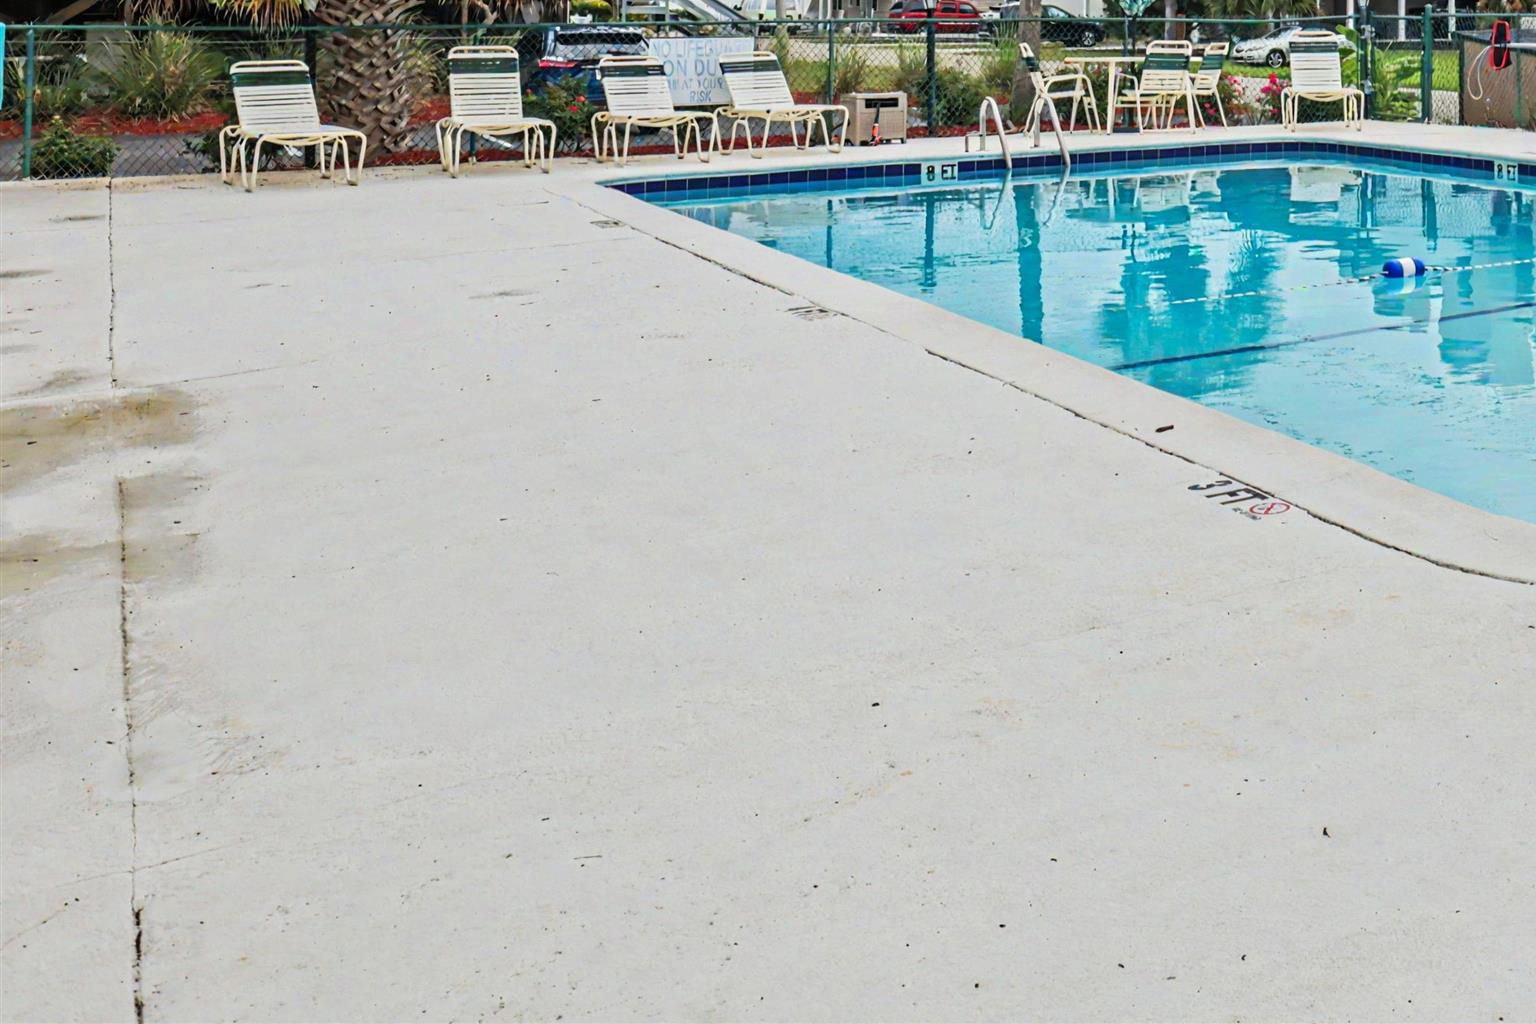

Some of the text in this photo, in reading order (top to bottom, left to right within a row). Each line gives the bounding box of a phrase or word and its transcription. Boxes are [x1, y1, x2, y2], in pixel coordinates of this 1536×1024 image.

[663, 59, 718, 76] ON DU
[690, 90, 712, 103] RISK
[1188, 480, 1270, 506] 3 FT
